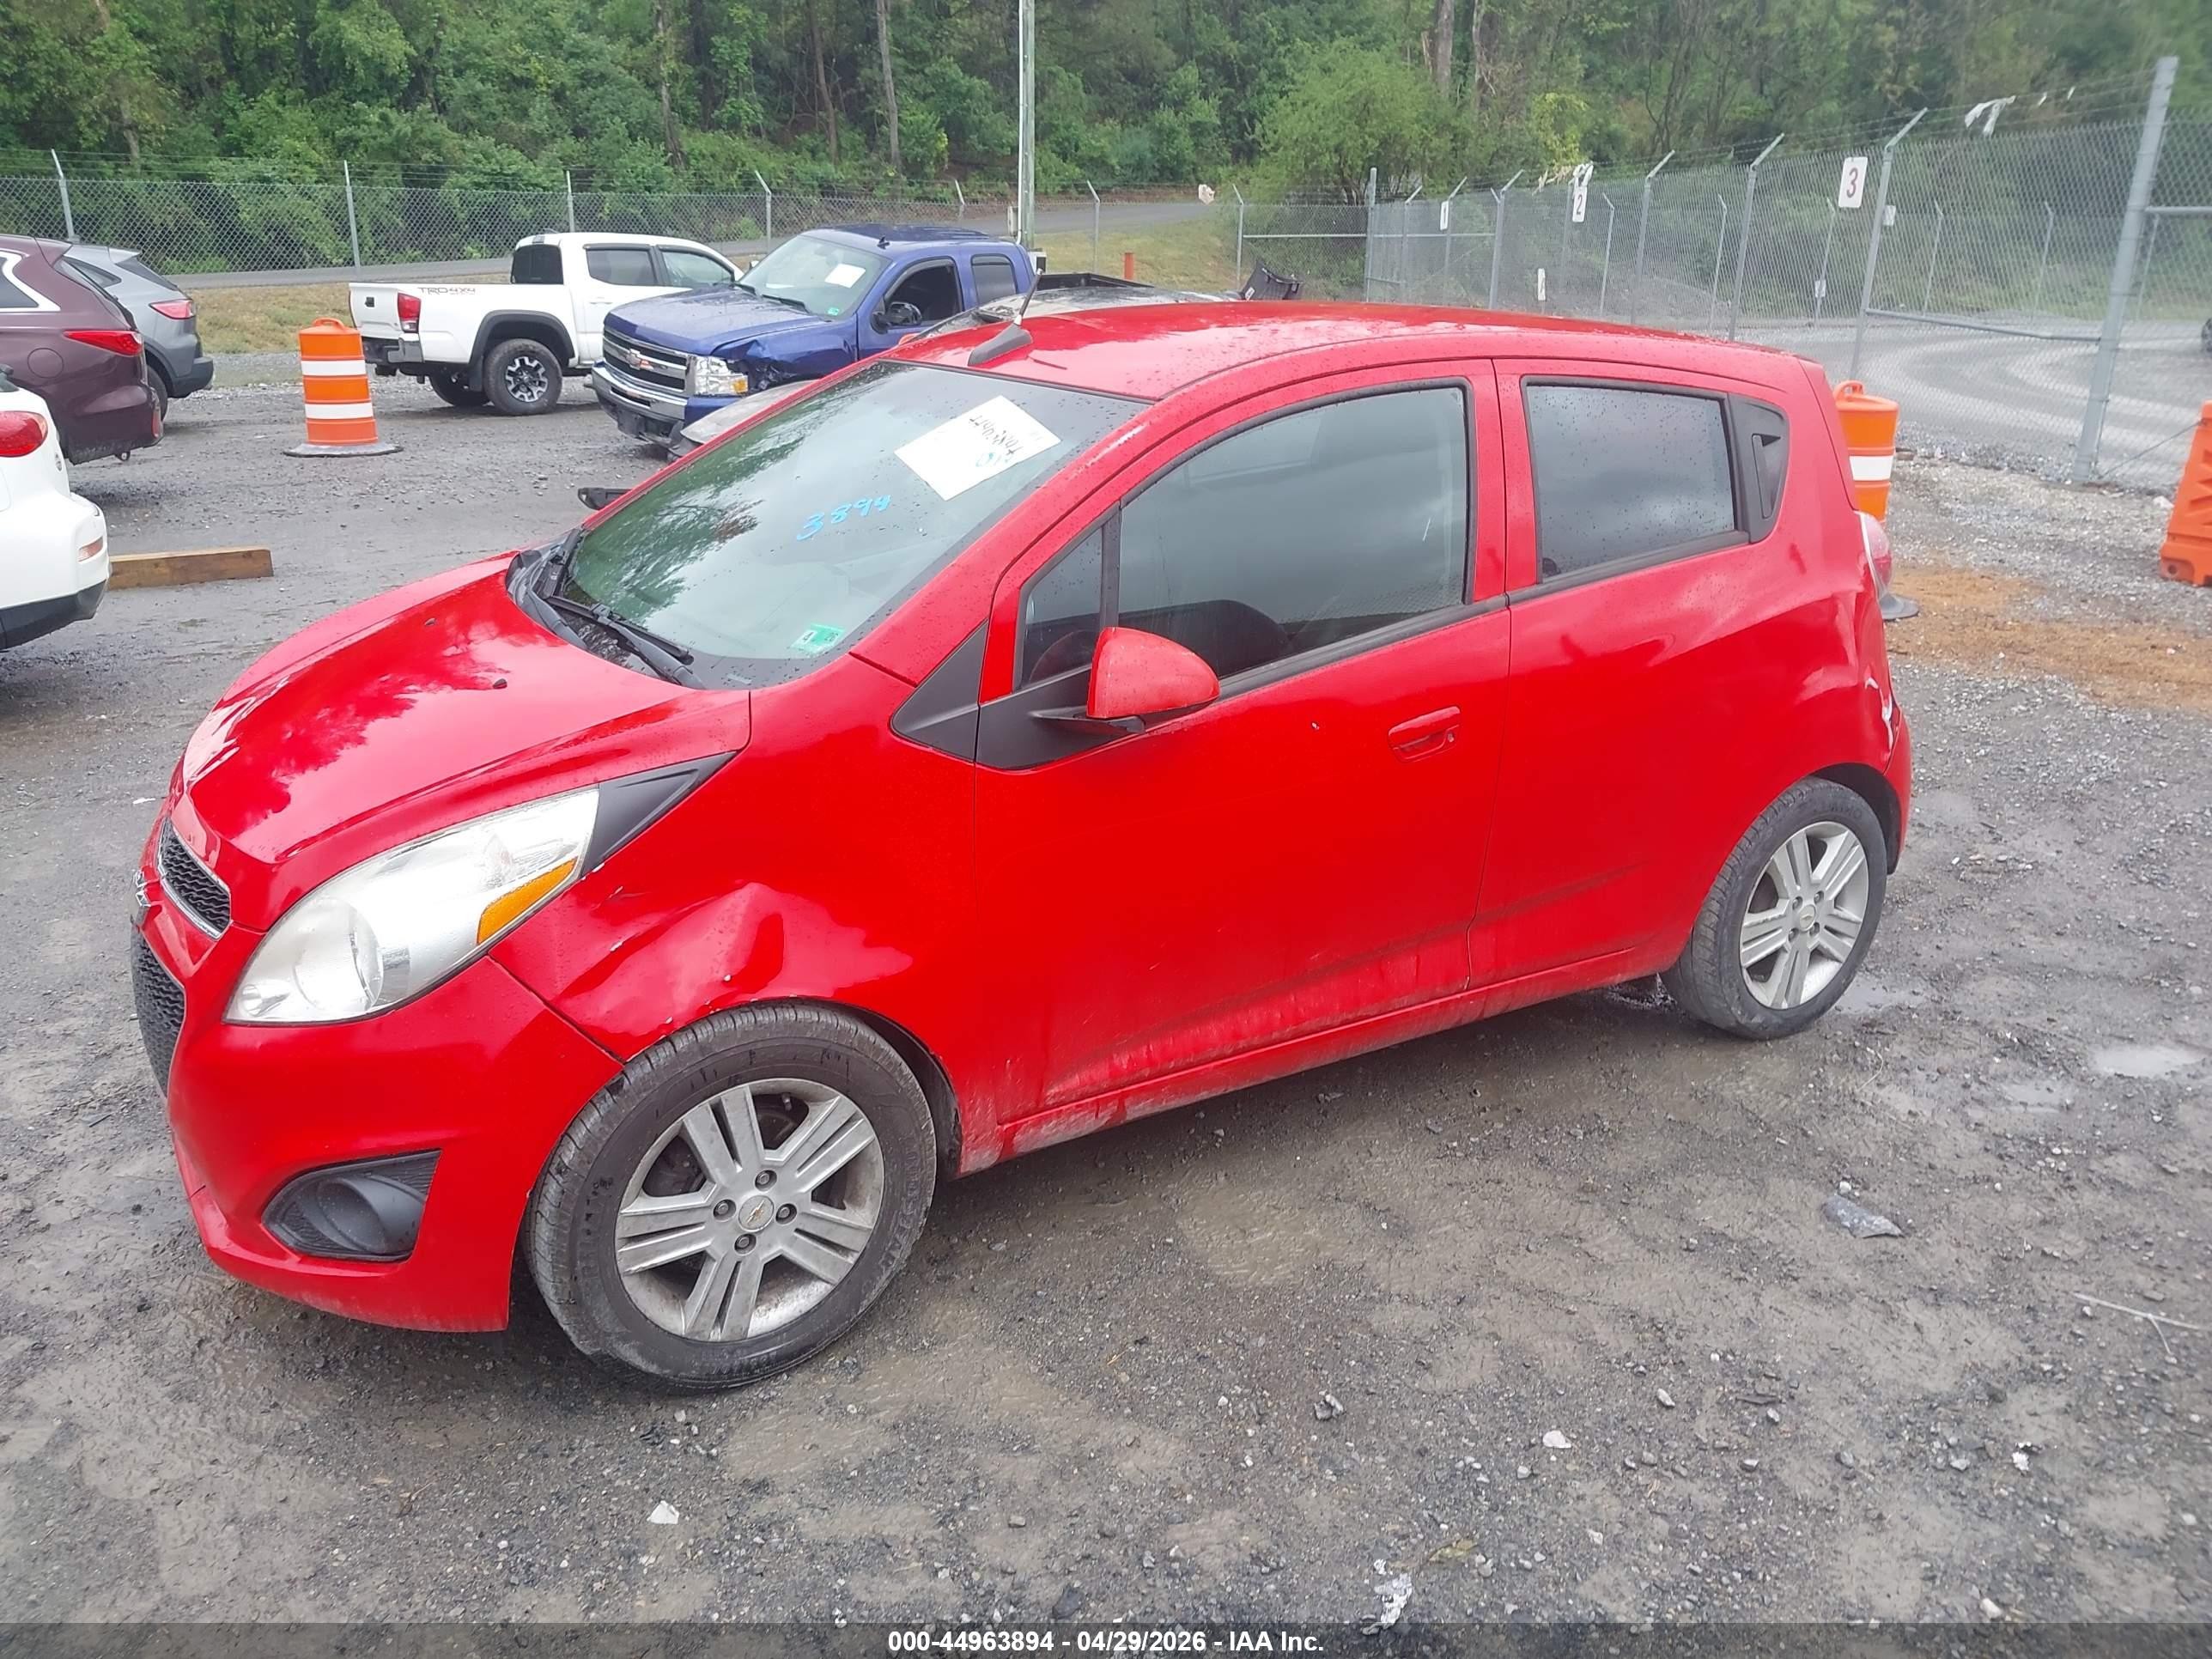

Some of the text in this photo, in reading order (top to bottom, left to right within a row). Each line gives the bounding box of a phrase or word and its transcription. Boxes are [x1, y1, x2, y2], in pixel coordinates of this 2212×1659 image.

[1847, 167, 1858, 198] 3
[1576, 194, 1583, 215] 2
[796, 495, 891, 541] 3894
